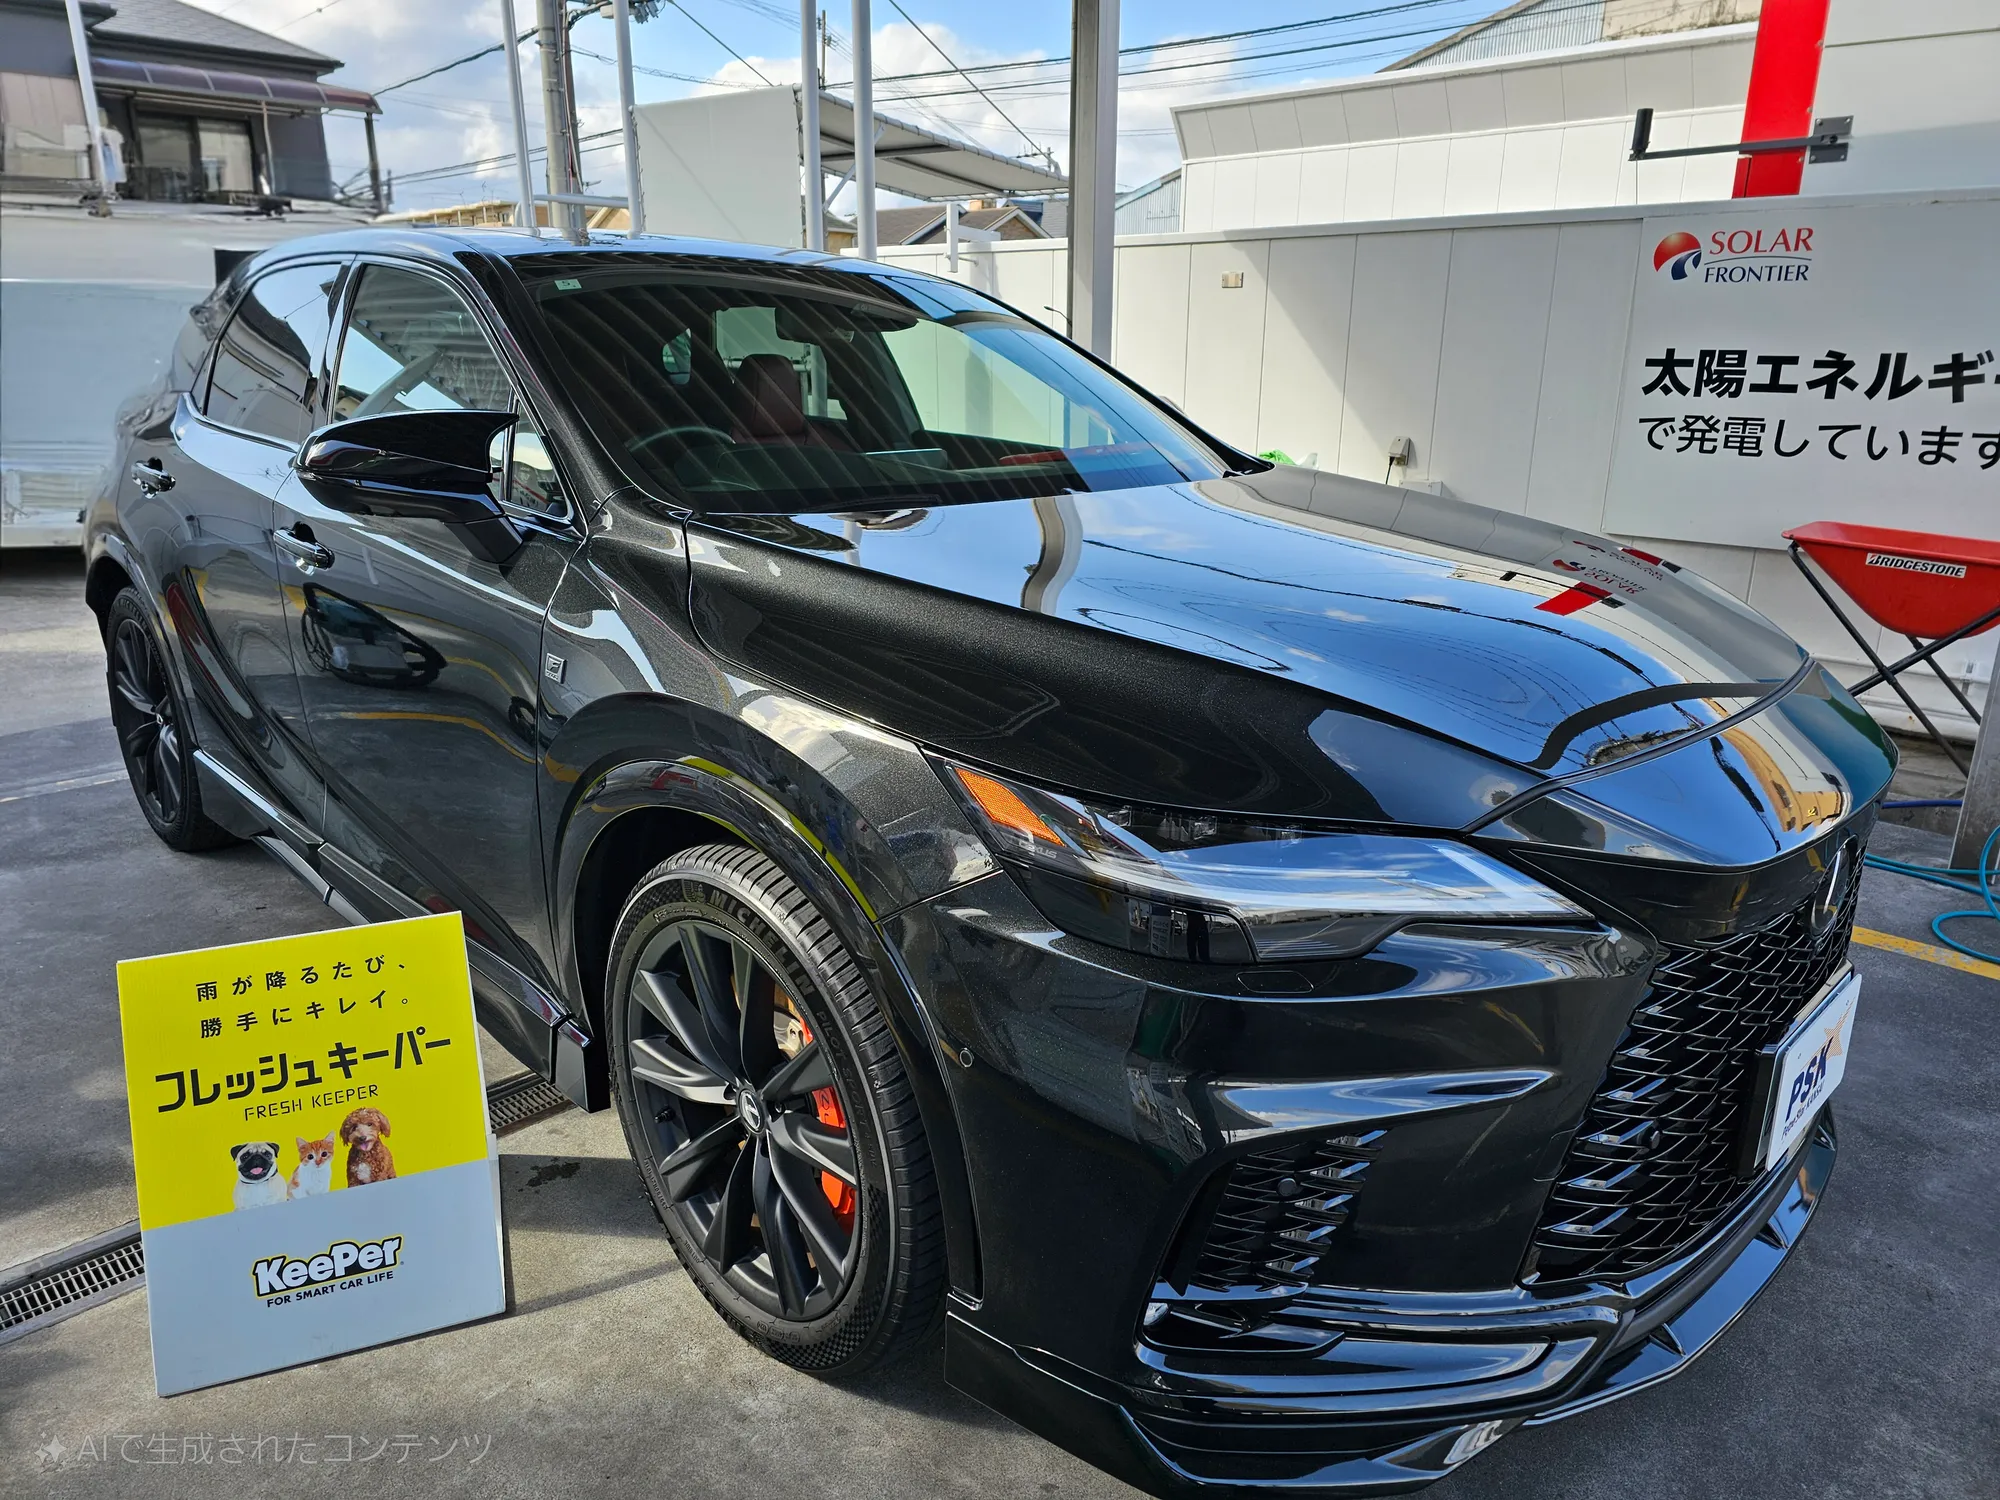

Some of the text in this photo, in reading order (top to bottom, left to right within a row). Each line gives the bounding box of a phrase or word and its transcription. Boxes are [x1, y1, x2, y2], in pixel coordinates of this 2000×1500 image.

[1709, 228, 1814, 255] SOLAR
[1704, 264, 1809, 283] FRONTIER
[1641, 348, 2000, 404] 太陽エネルギ
[1638, 414, 2000, 470] で発電しています
[1867, 553, 1965, 577] BRIDGESTONE
[711, 890, 815, 995] MICHELIN
[196, 954, 406, 1002] 雨が降るたび、
[200, 990, 410, 1038] 勝手にキレイ。
[155, 1026, 451, 1113] フレッシュキーパー
[815, 1011, 848, 1062] PILOT
[842, 1067, 868, 1128] SPORT
[1785, 1036, 1834, 1123] PSK
[245, 1084, 379, 1121] FRESH KEEPER
[254, 1237, 402, 1297] KeePer
[267, 1270, 394, 1307] FOR SMART CAR LIFE
